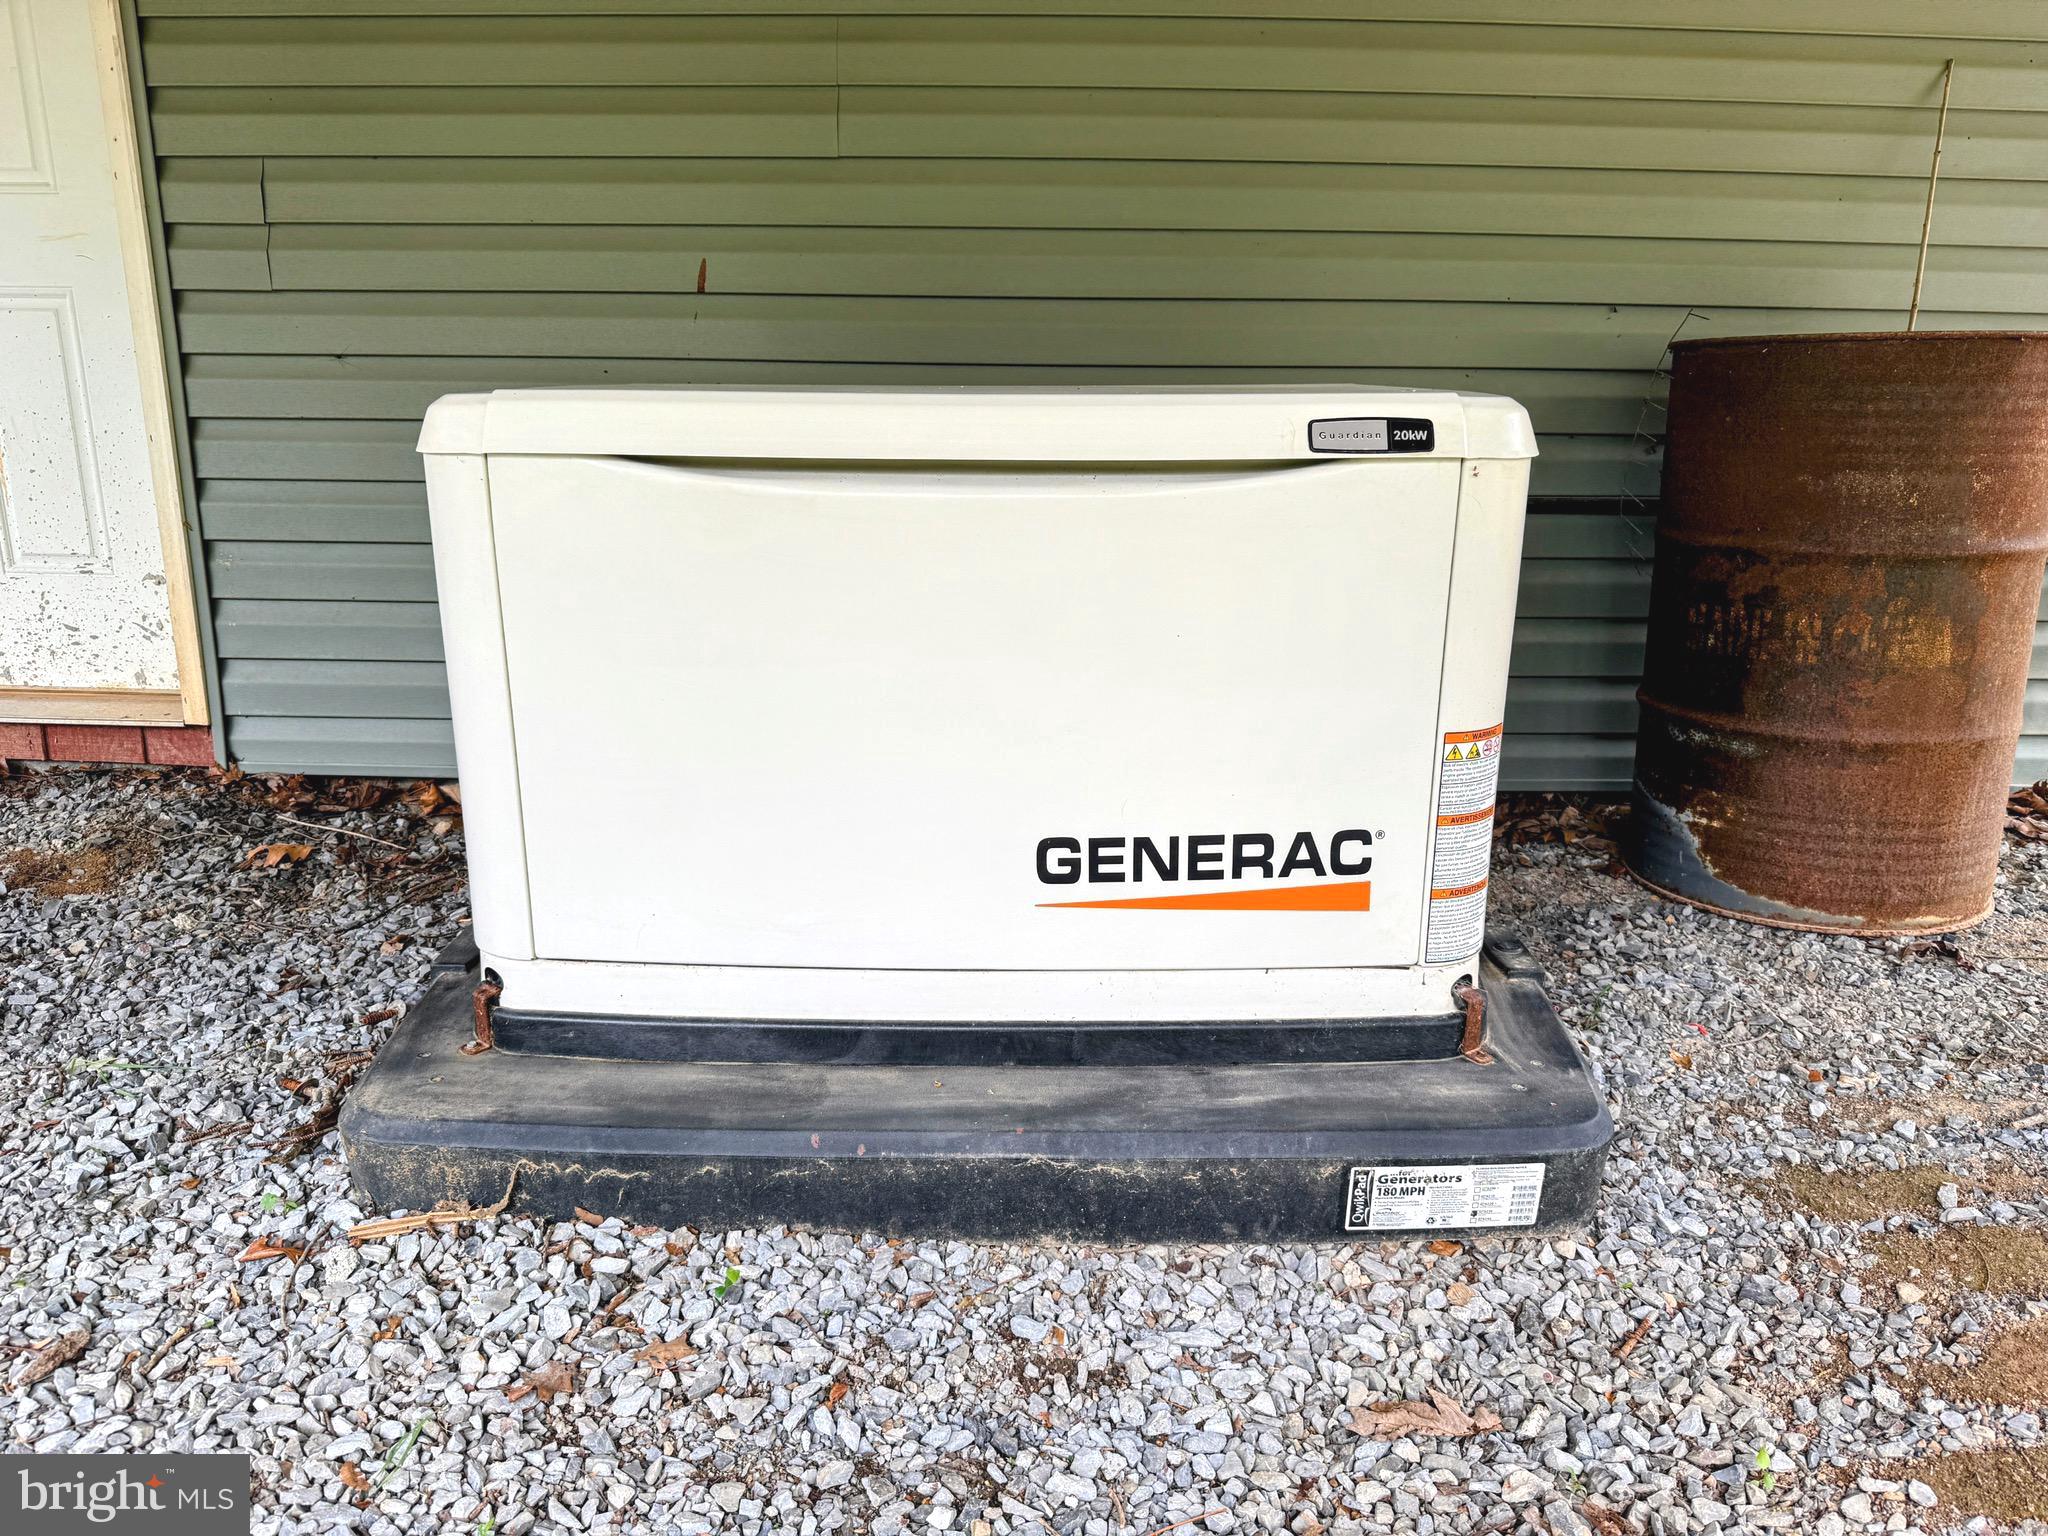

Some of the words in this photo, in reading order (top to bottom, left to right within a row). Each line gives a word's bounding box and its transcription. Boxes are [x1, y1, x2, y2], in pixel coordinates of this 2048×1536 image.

[1318, 431, 1381, 440] Guardian
[1393, 430, 1428, 441] 20kW
[1377, 1174, 1463, 1185] Generators
[1376, 1186, 1397, 1197] 180
[1399, 1186, 1426, 1196] MPH
[1351, 1174, 1368, 1223] QwikPad
